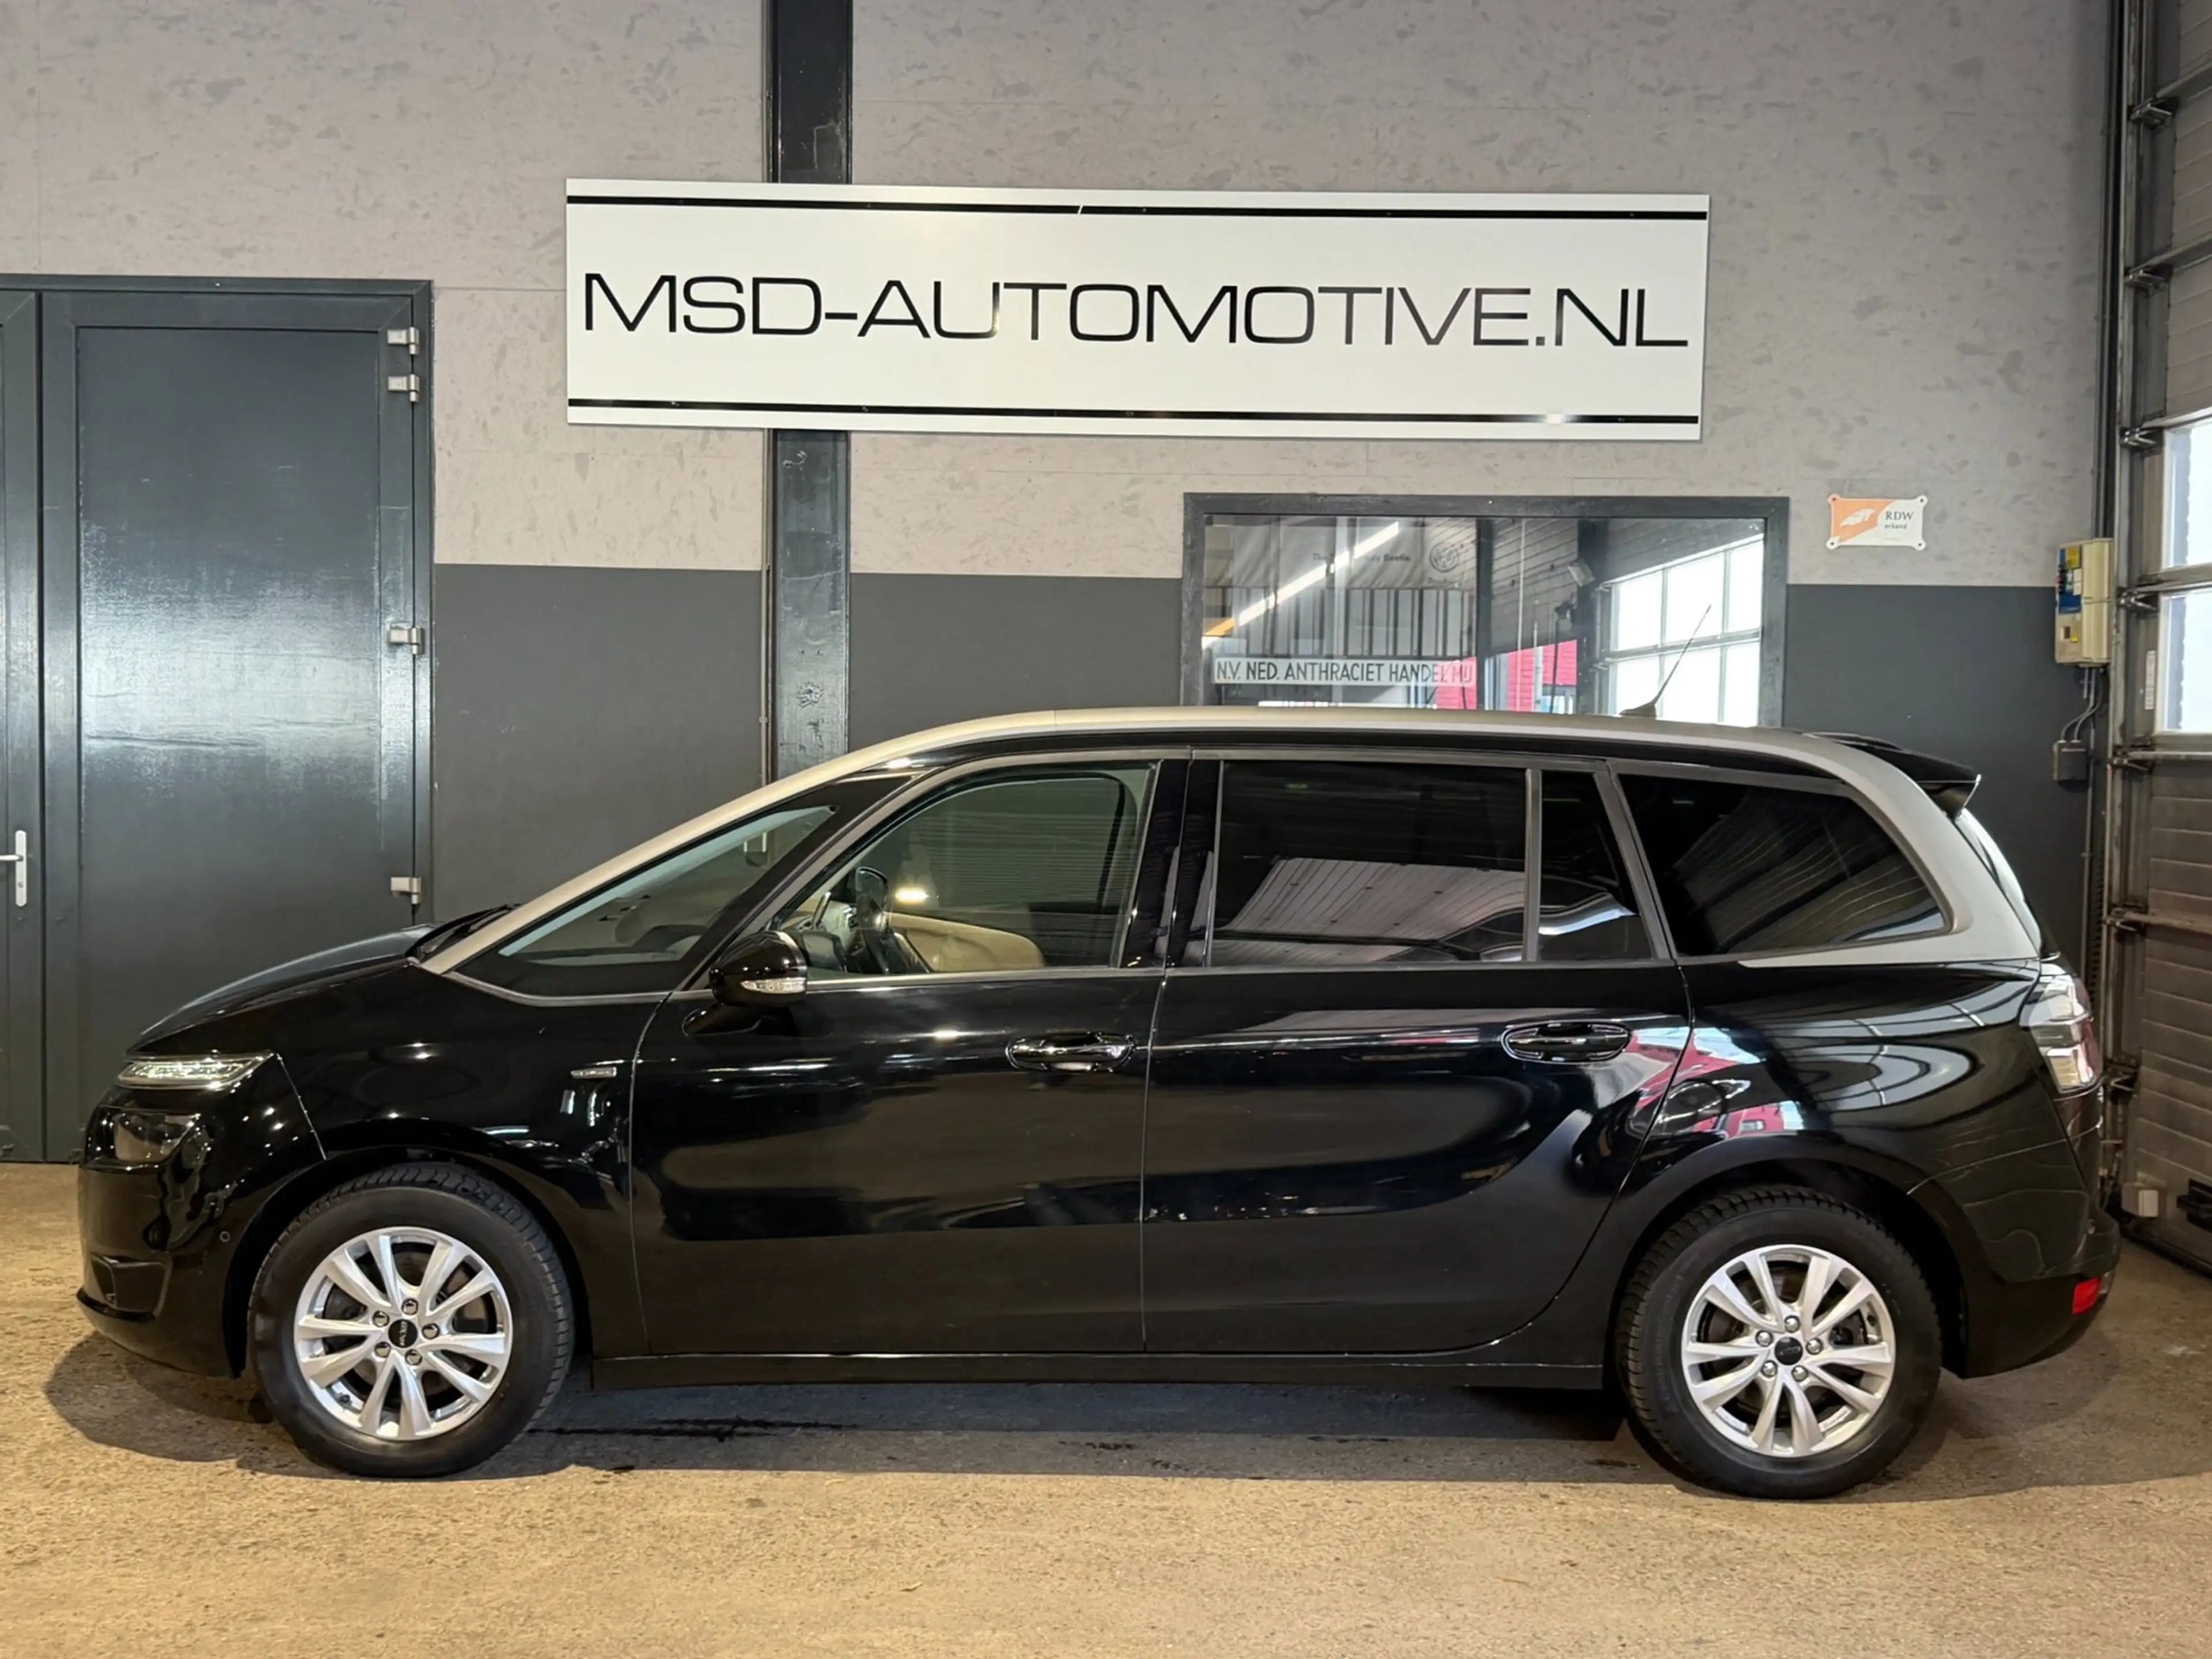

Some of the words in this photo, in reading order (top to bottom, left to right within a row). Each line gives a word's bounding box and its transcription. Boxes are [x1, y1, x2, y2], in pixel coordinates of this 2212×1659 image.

[584, 272, 1689, 347] MSD-AUTOMOTIVE.NL
[1885, 511, 1915, 521] RDW
[1217, 661, 1241, 680] N.V.
[1246, 661, 1281, 680] NED.
[1283, 662, 1384, 681] ANTHRACIET
[1389, 663, 1448, 683] HANDEL
